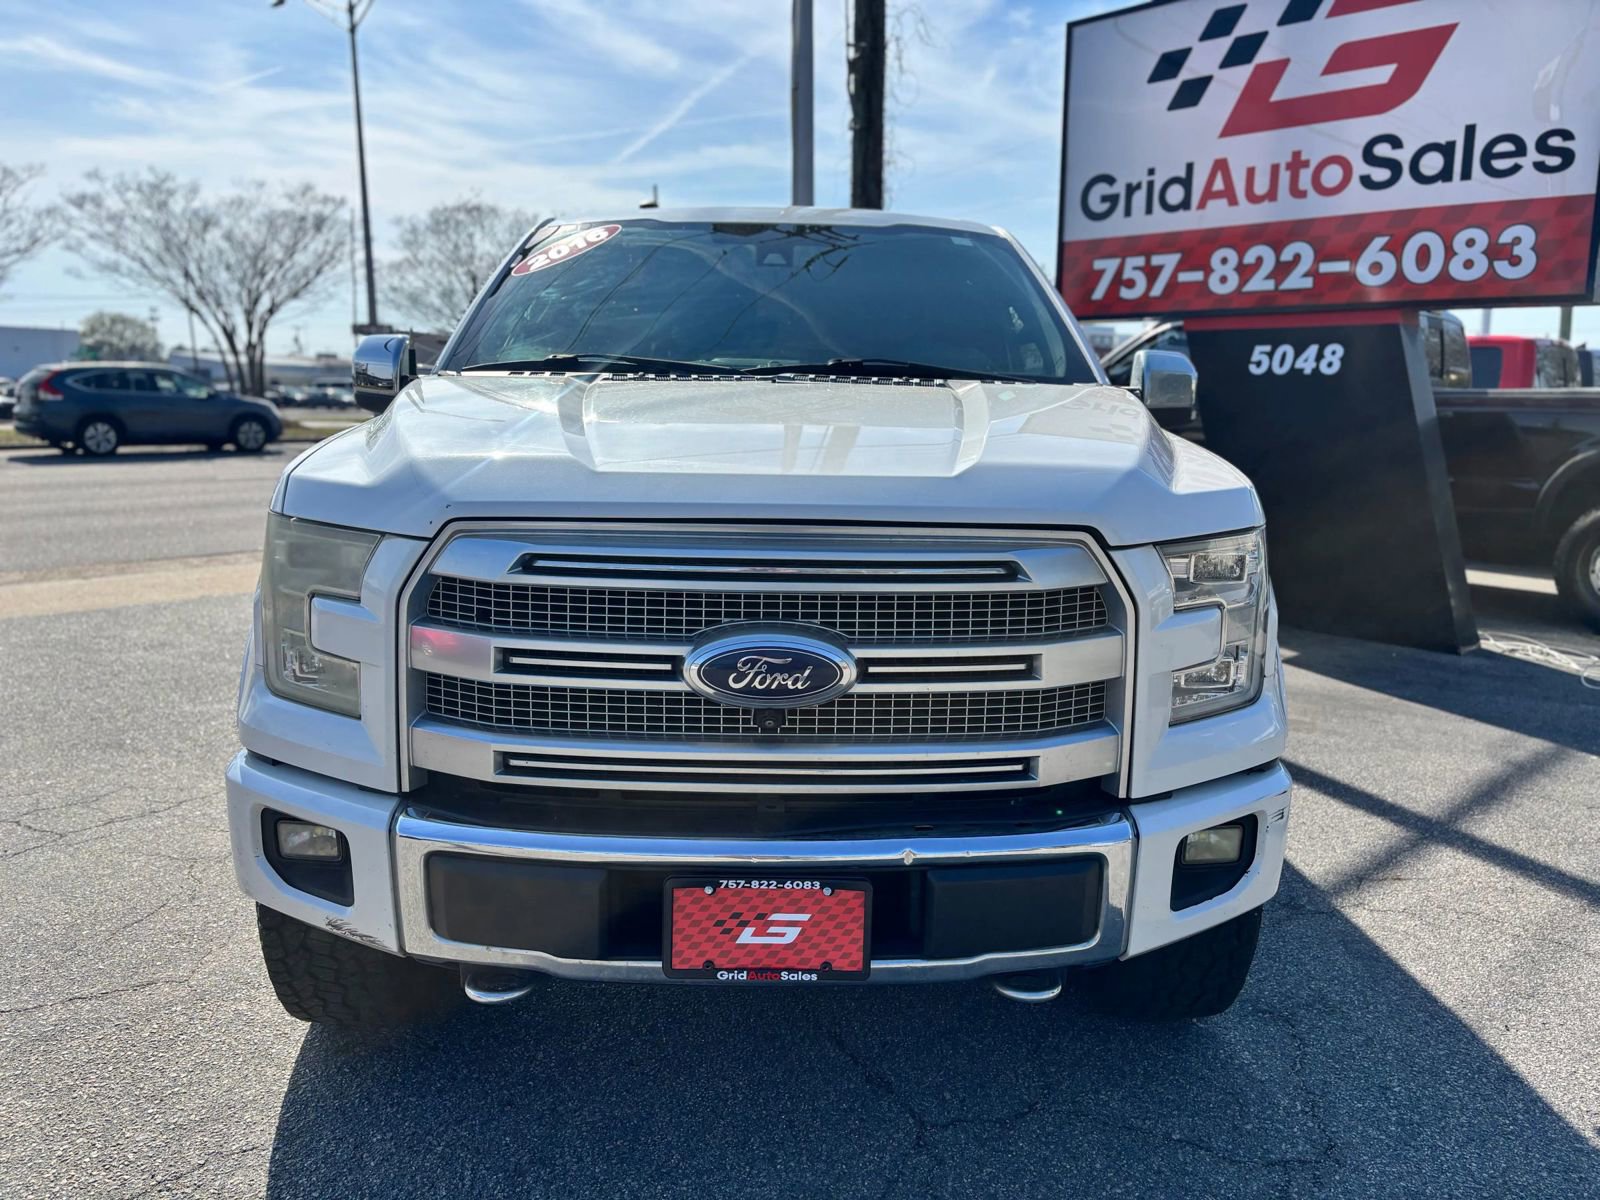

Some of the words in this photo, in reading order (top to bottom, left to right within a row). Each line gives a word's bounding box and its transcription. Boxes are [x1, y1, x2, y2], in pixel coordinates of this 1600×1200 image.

[1080, 124, 1576, 222] GridAutoSales
[527, 228, 609, 271] 2016
[1090, 224, 1538, 301] 757-822-6083
[1247, 343, 1345, 376] 5048
[728, 655, 814, 690] Ford
[719, 879, 821, 890] 757-822-6083
[716, 970, 818, 981] GridAutoSales
